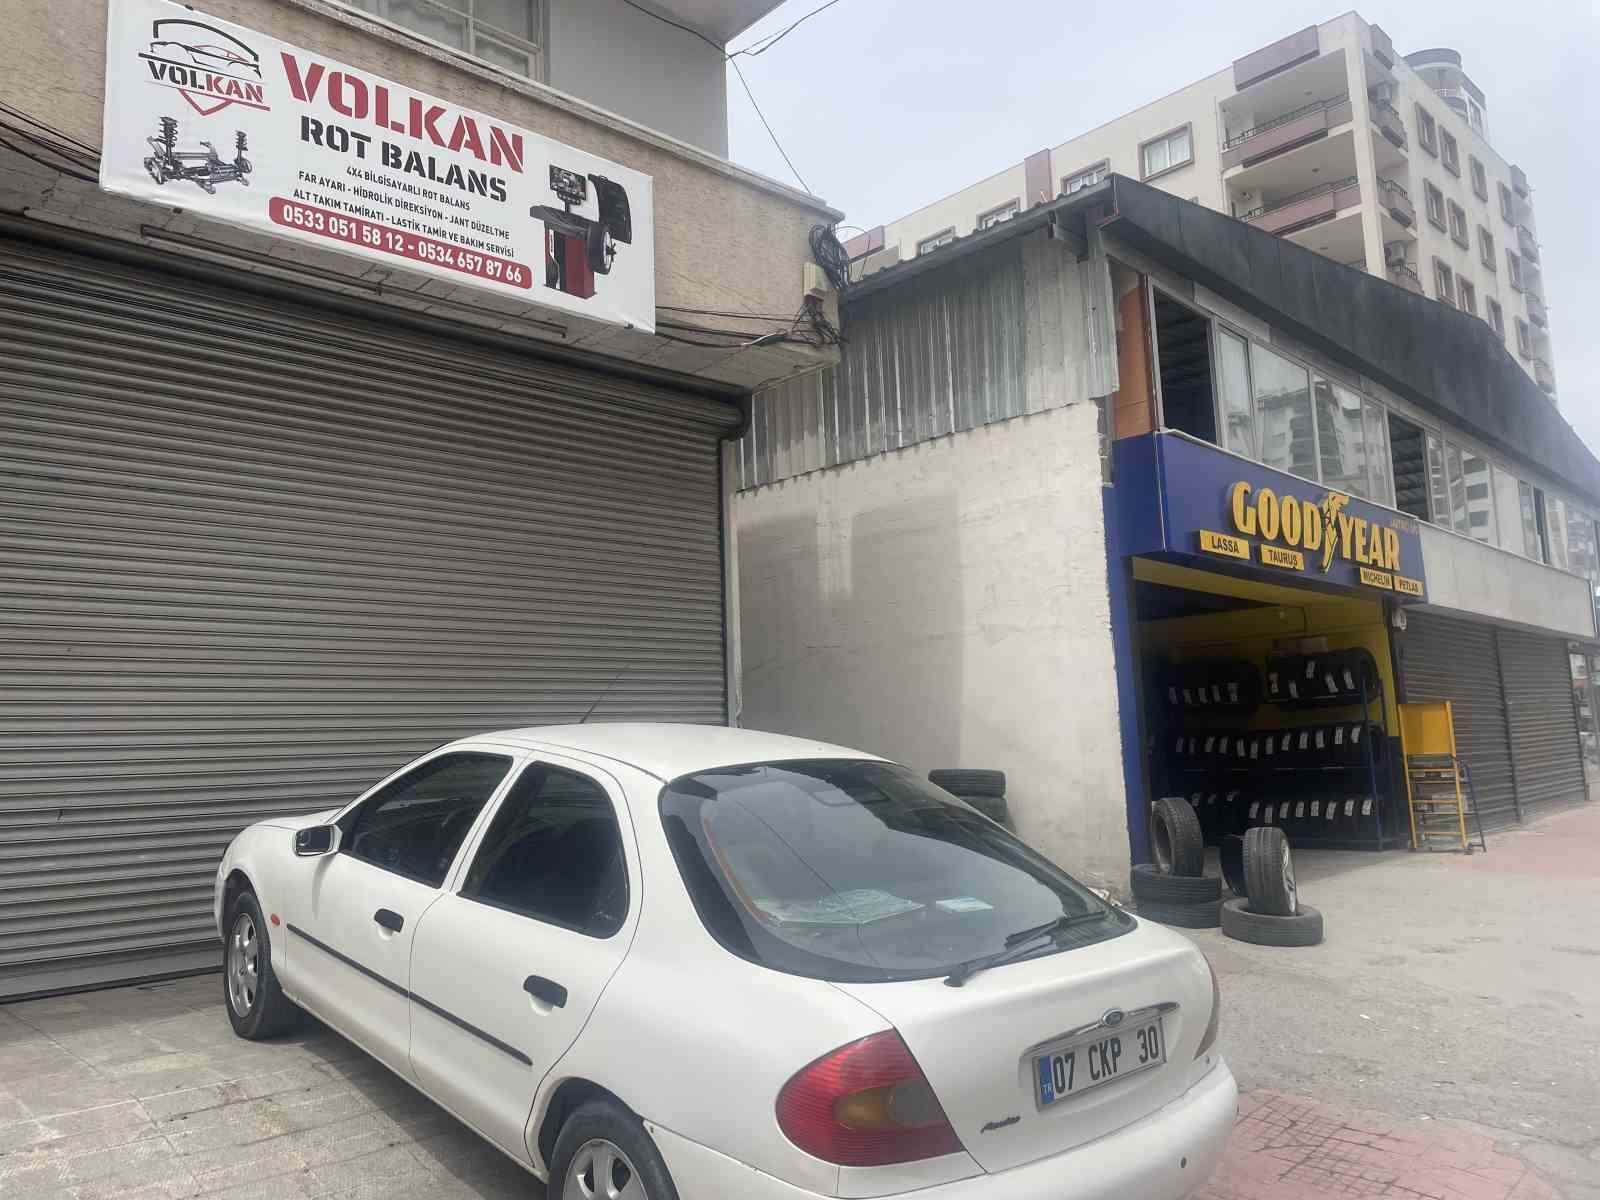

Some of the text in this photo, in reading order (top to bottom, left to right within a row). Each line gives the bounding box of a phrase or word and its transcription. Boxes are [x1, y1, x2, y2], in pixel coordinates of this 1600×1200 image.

[147, 60, 263, 104] VOLKAN
[280, 51, 524, 174] VOLKAN
[300, 115, 507, 203] ROT BALANS
[346, 165, 471, 211] 4X4 BİLGİSAYARLI ROT BALANS
[293, 188, 312, 201] ALT
[313, 193, 341, 209] TAKIM
[343, 202, 384, 222] TAMİRATI
[391, 215, 421, 232] LASTİK
[422, 224, 447, 239] TAMİR
[448, 231, 459, 243] VE
[460, 235, 485, 250] BAKIM
[486, 243, 514, 258] SERVİSİ
[298, 170, 318, 184] FAR
[319, 176, 346, 193] AYARI
[353, 185, 393, 205] HİDROLİK
[395, 197, 443, 220] DİREKSİYON
[449, 215, 470, 228] JANT
[471, 220, 510, 240] DÜZELTME
[283, 204, 325, 231] 0533
[328, 216, 357, 240] 051
[362, 223, 381, 246] 58
[385, 231, 404, 252] 12
[418, 240, 454, 265] 0534
[457, 250, 483, 273] 657
[486, 259, 503, 278] 87
[505, 265, 522, 283] 66
[1211, 534, 1240, 555] LASSA
[1267, 549, 1299, 568] TAURUS
[1053, 1025, 1159, 1094] 07 CKP 30
